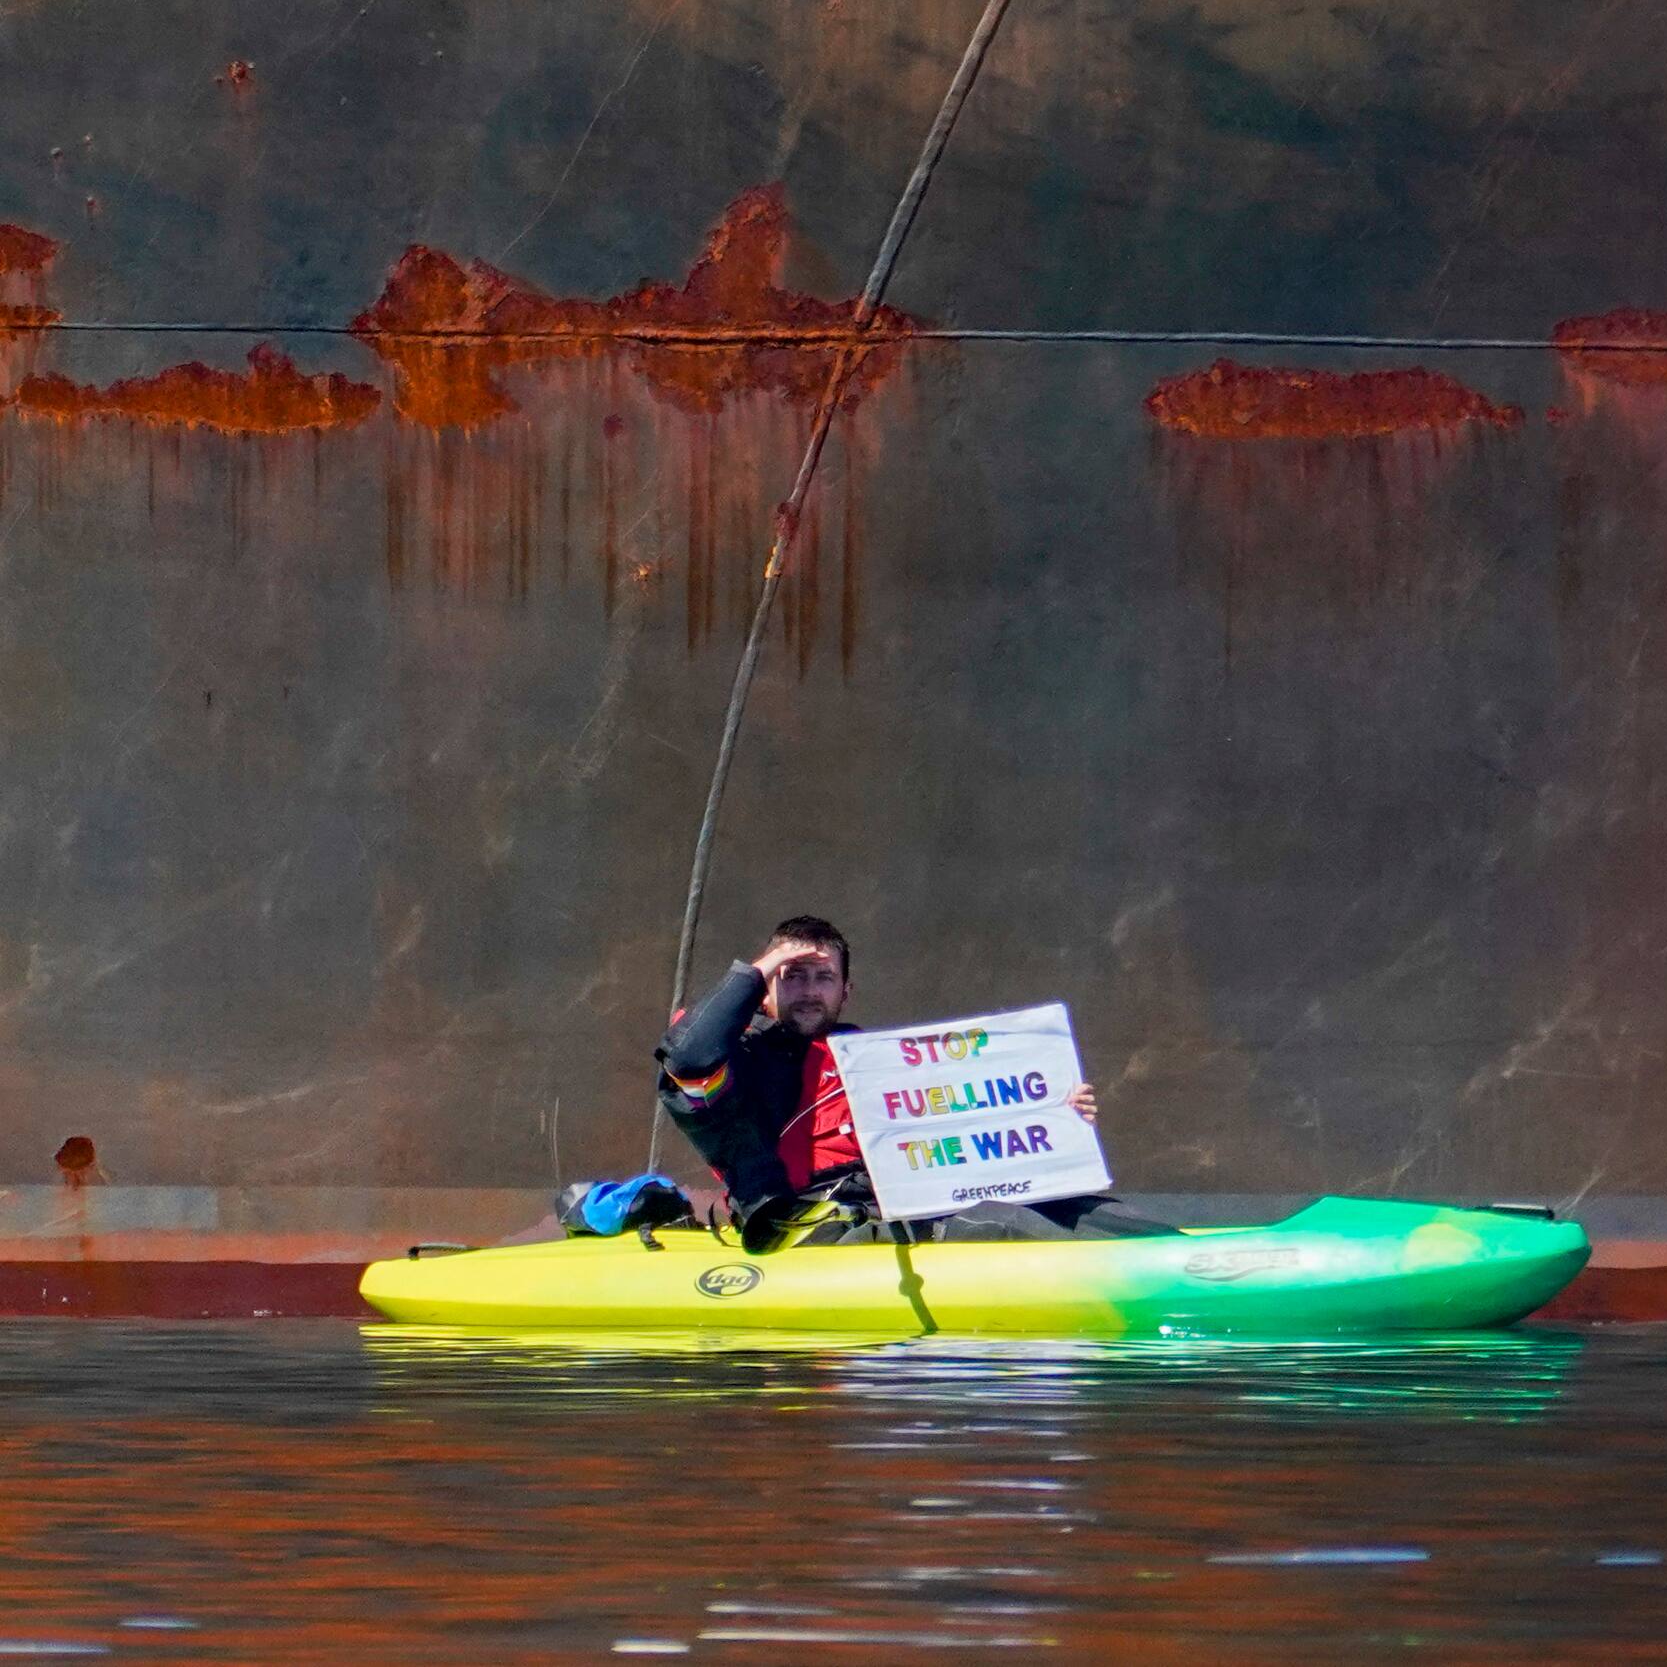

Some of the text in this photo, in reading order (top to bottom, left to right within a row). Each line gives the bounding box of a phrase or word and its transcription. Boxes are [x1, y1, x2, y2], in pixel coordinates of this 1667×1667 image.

[899, 1027, 989, 1066] STOP
[883, 1071, 1048, 1120] FUELLING
[897, 1124, 1053, 1171] THE WAR
[951, 1180, 1032, 1202] GREENPEACE
